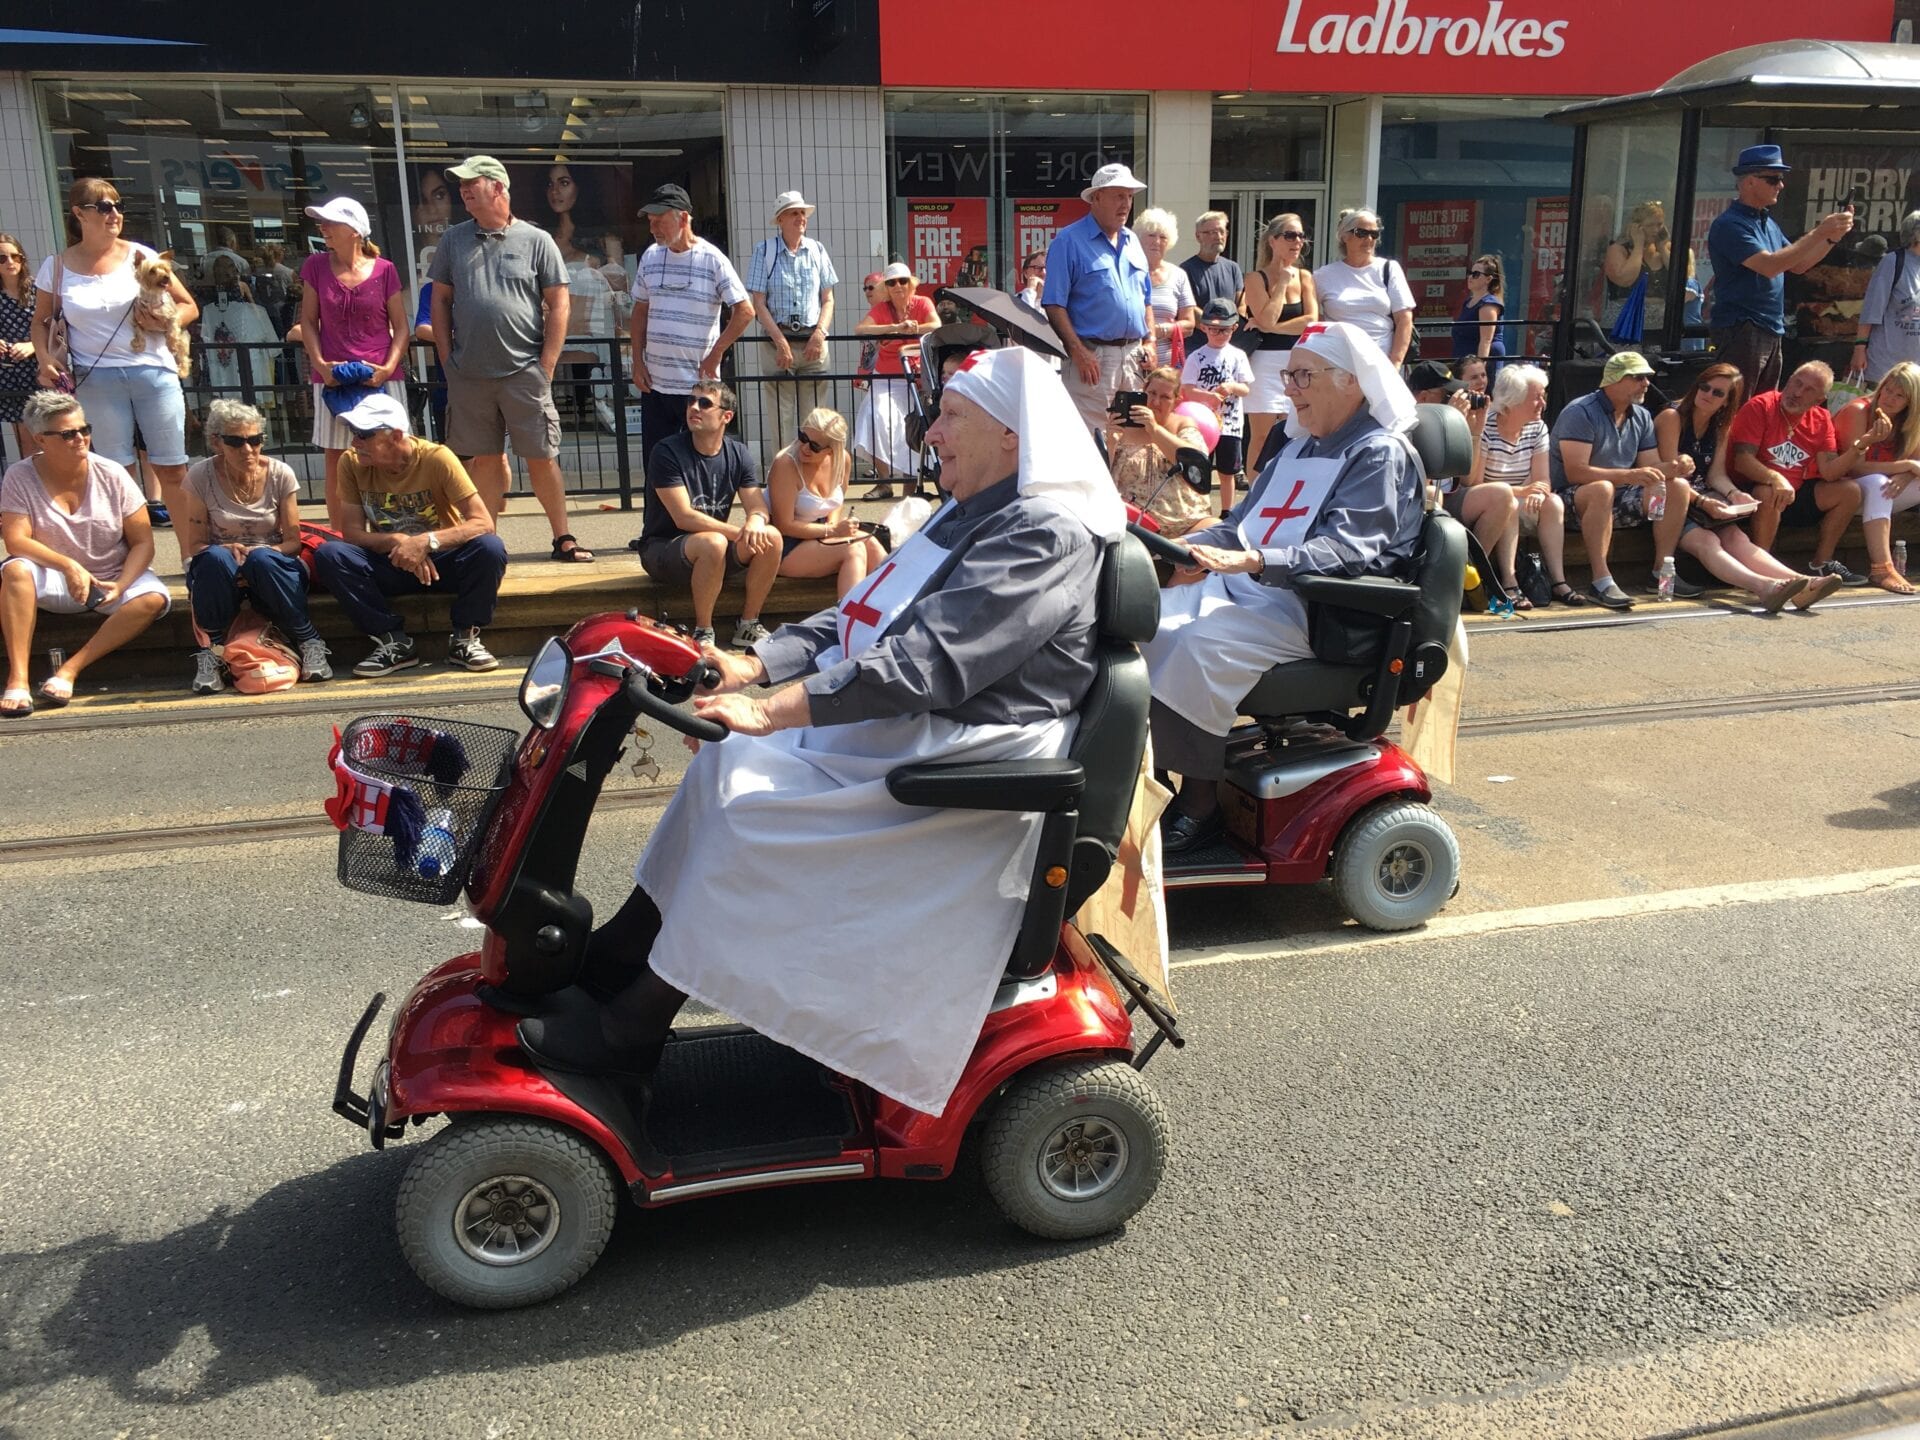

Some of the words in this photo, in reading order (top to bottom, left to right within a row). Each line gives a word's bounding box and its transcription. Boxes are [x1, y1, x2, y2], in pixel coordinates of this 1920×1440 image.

[1276, 0, 1569, 58] Ladbrokes
[1807, 168, 1912, 201] HURRY
[914, 214, 948, 225] BetStation
[1409, 210, 1449, 225] WHAT'S
[1451, 208, 1469, 223] THE
[1804, 201, 1908, 233] HRRY
[1418, 224, 1458, 239] SCORE?
[914, 227, 962, 257] FREE
[1424, 247, 1450, 255] FRANCE
[915, 258, 949, 284] BET
[1421, 269, 1450, 278] CROATIA
[1428, 287, 1441, 296] 2-1
